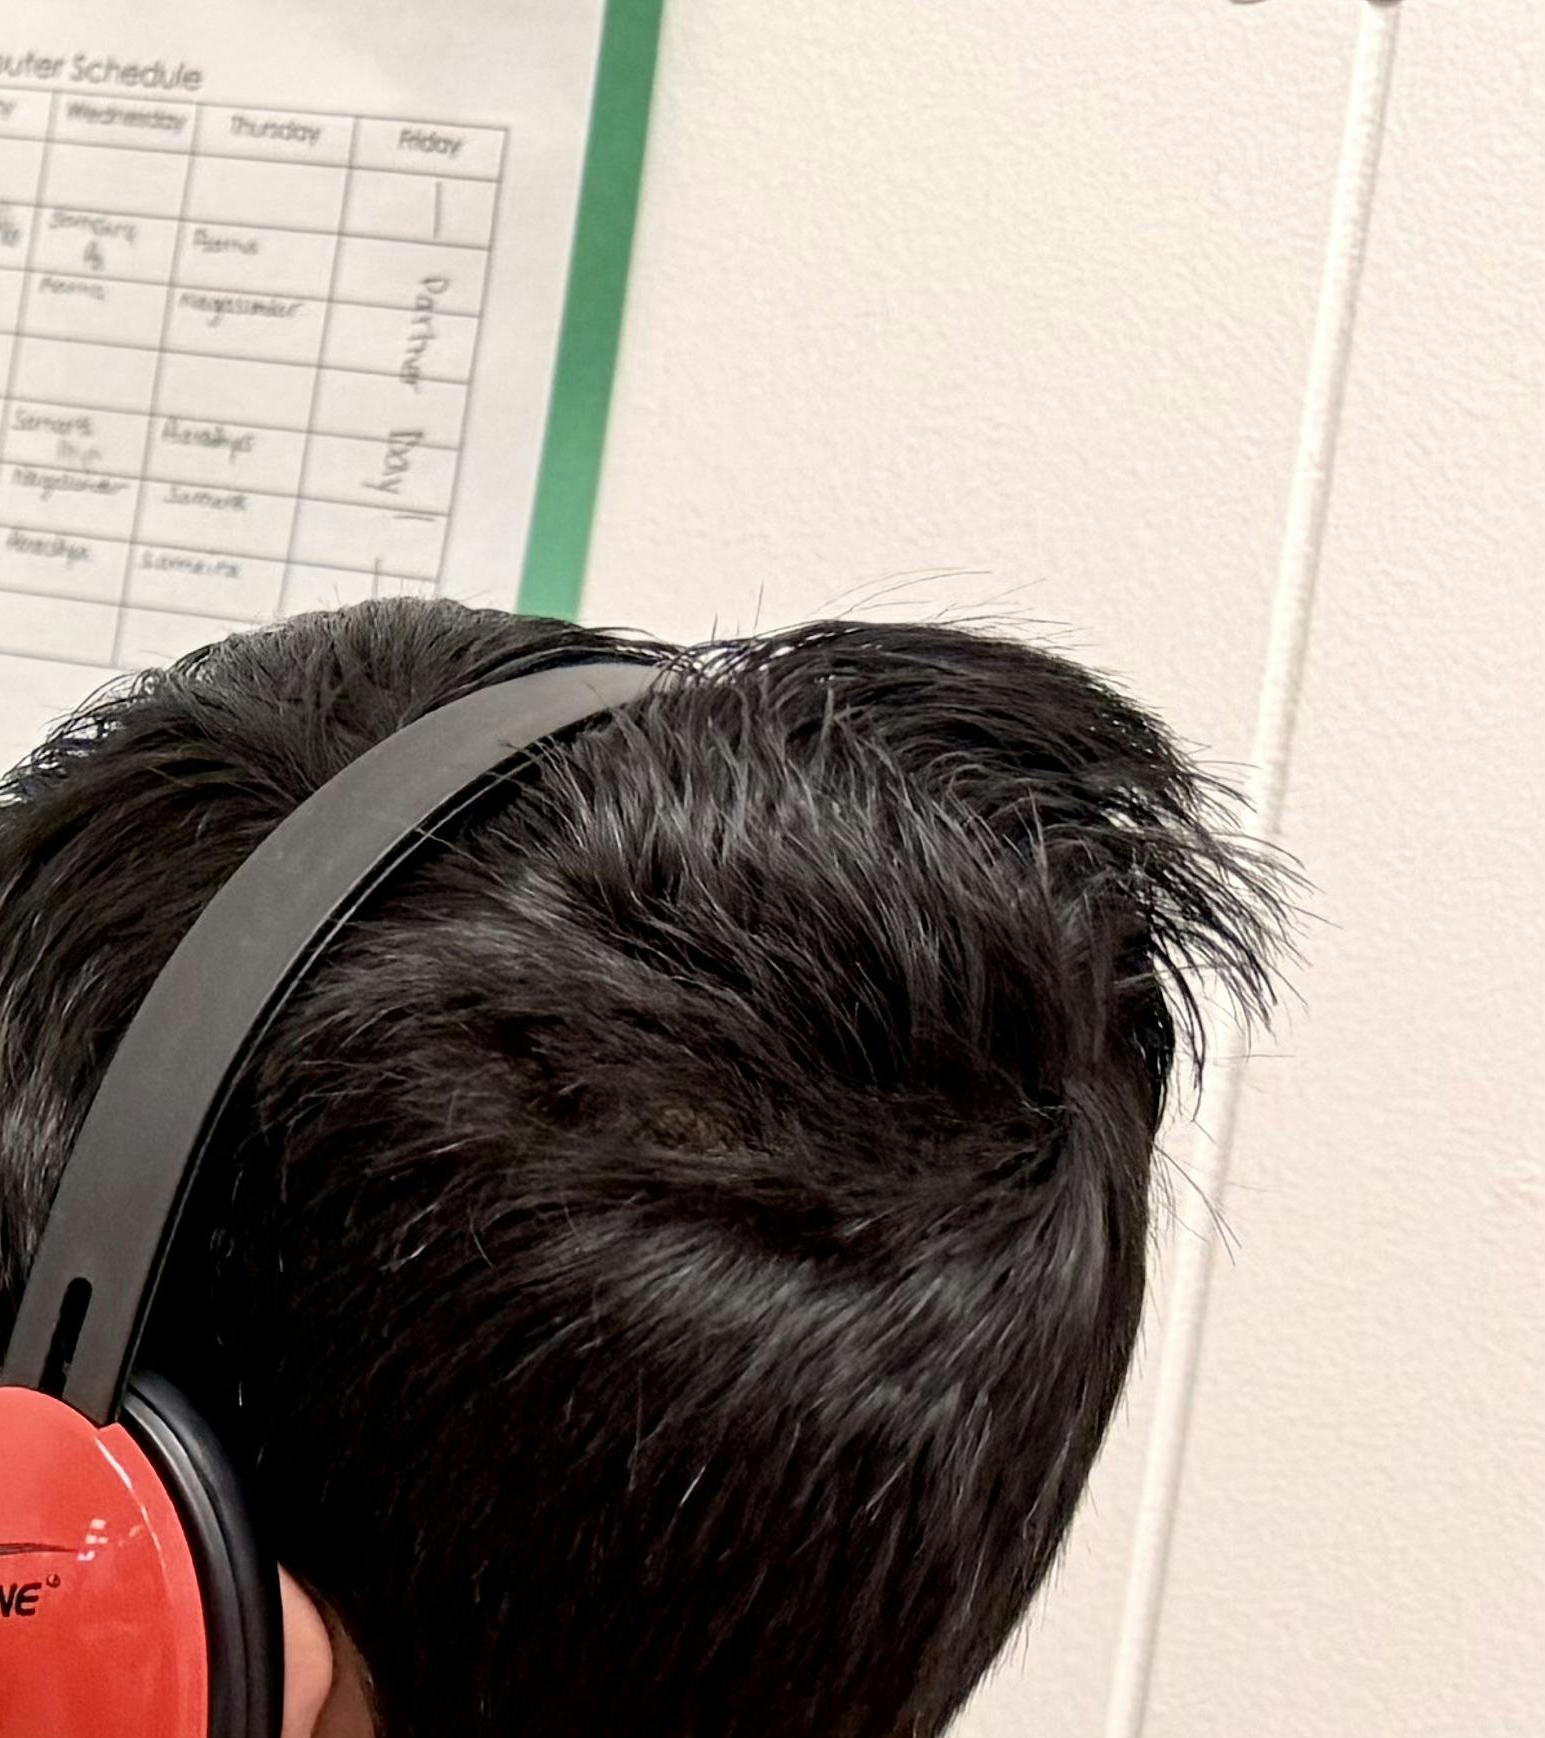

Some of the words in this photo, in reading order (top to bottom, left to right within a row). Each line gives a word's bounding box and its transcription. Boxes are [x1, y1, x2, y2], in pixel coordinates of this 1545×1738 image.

[70, 53, 203, 91] Schedule
[229, 114, 321, 145] Thursday
[398, 129, 464, 158] Friday
